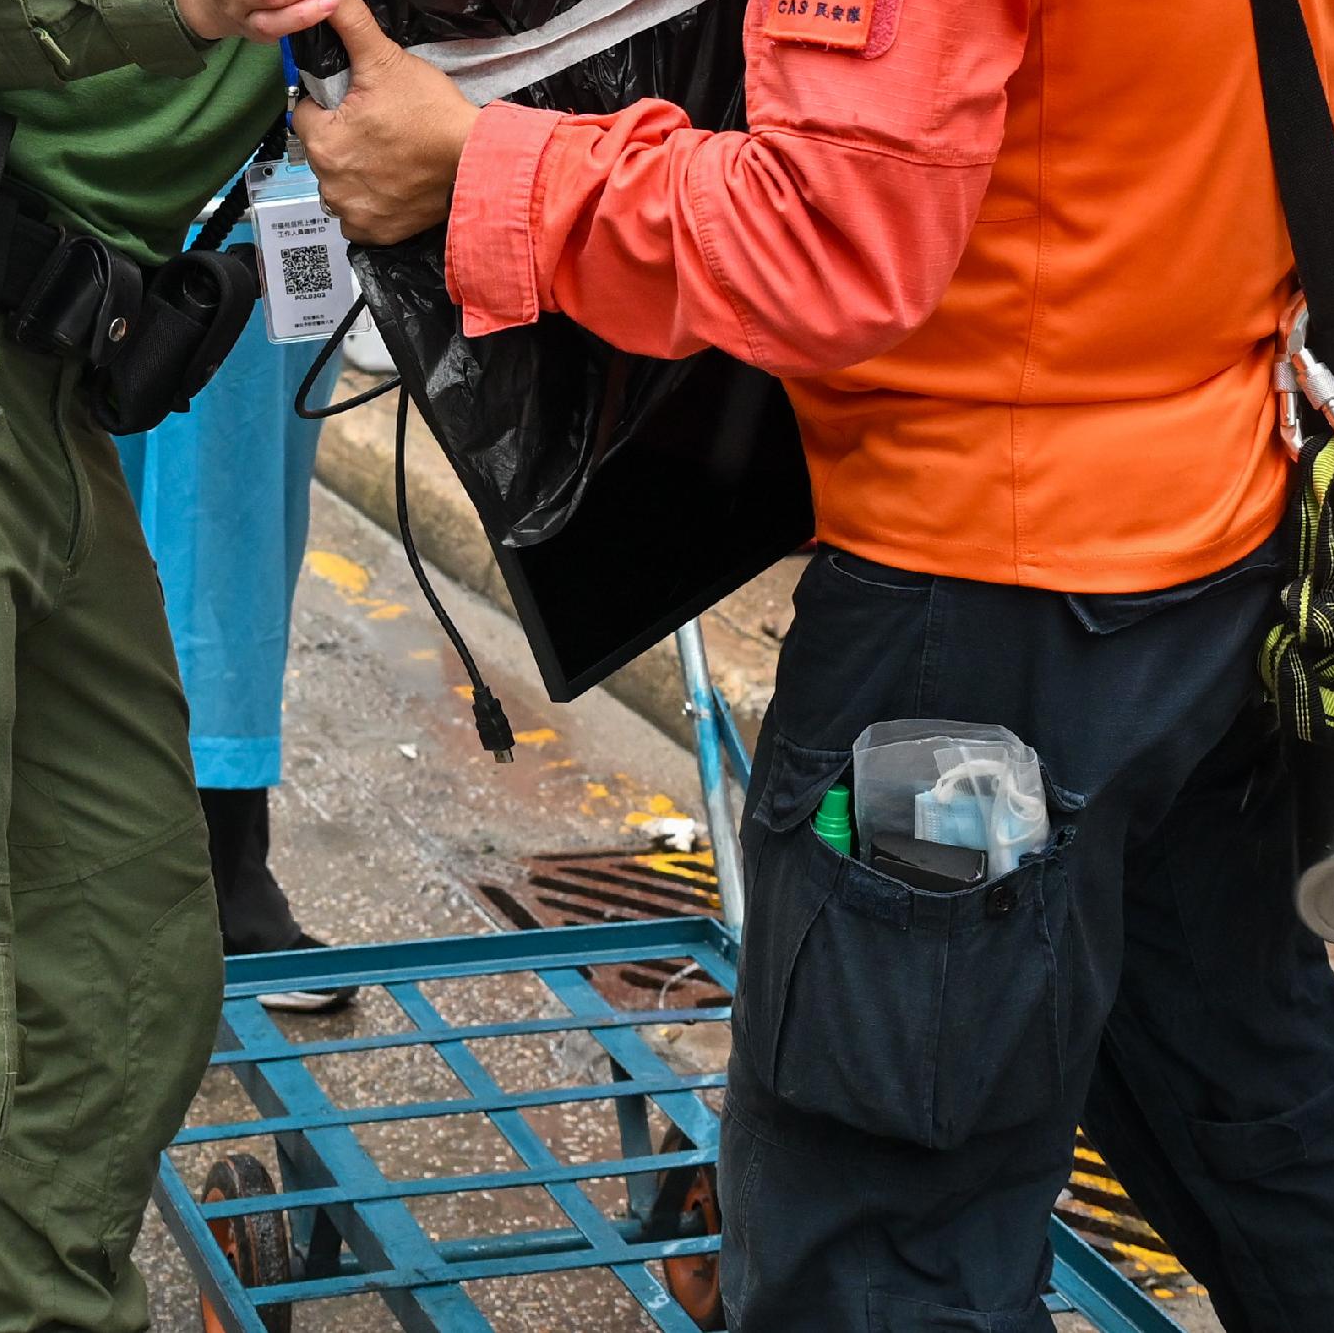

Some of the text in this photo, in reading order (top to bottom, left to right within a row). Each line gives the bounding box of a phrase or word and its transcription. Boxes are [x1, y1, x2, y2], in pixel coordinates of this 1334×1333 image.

[778, 0, 809, 15] CAS
[815, 2, 861, 23] 民安隊
